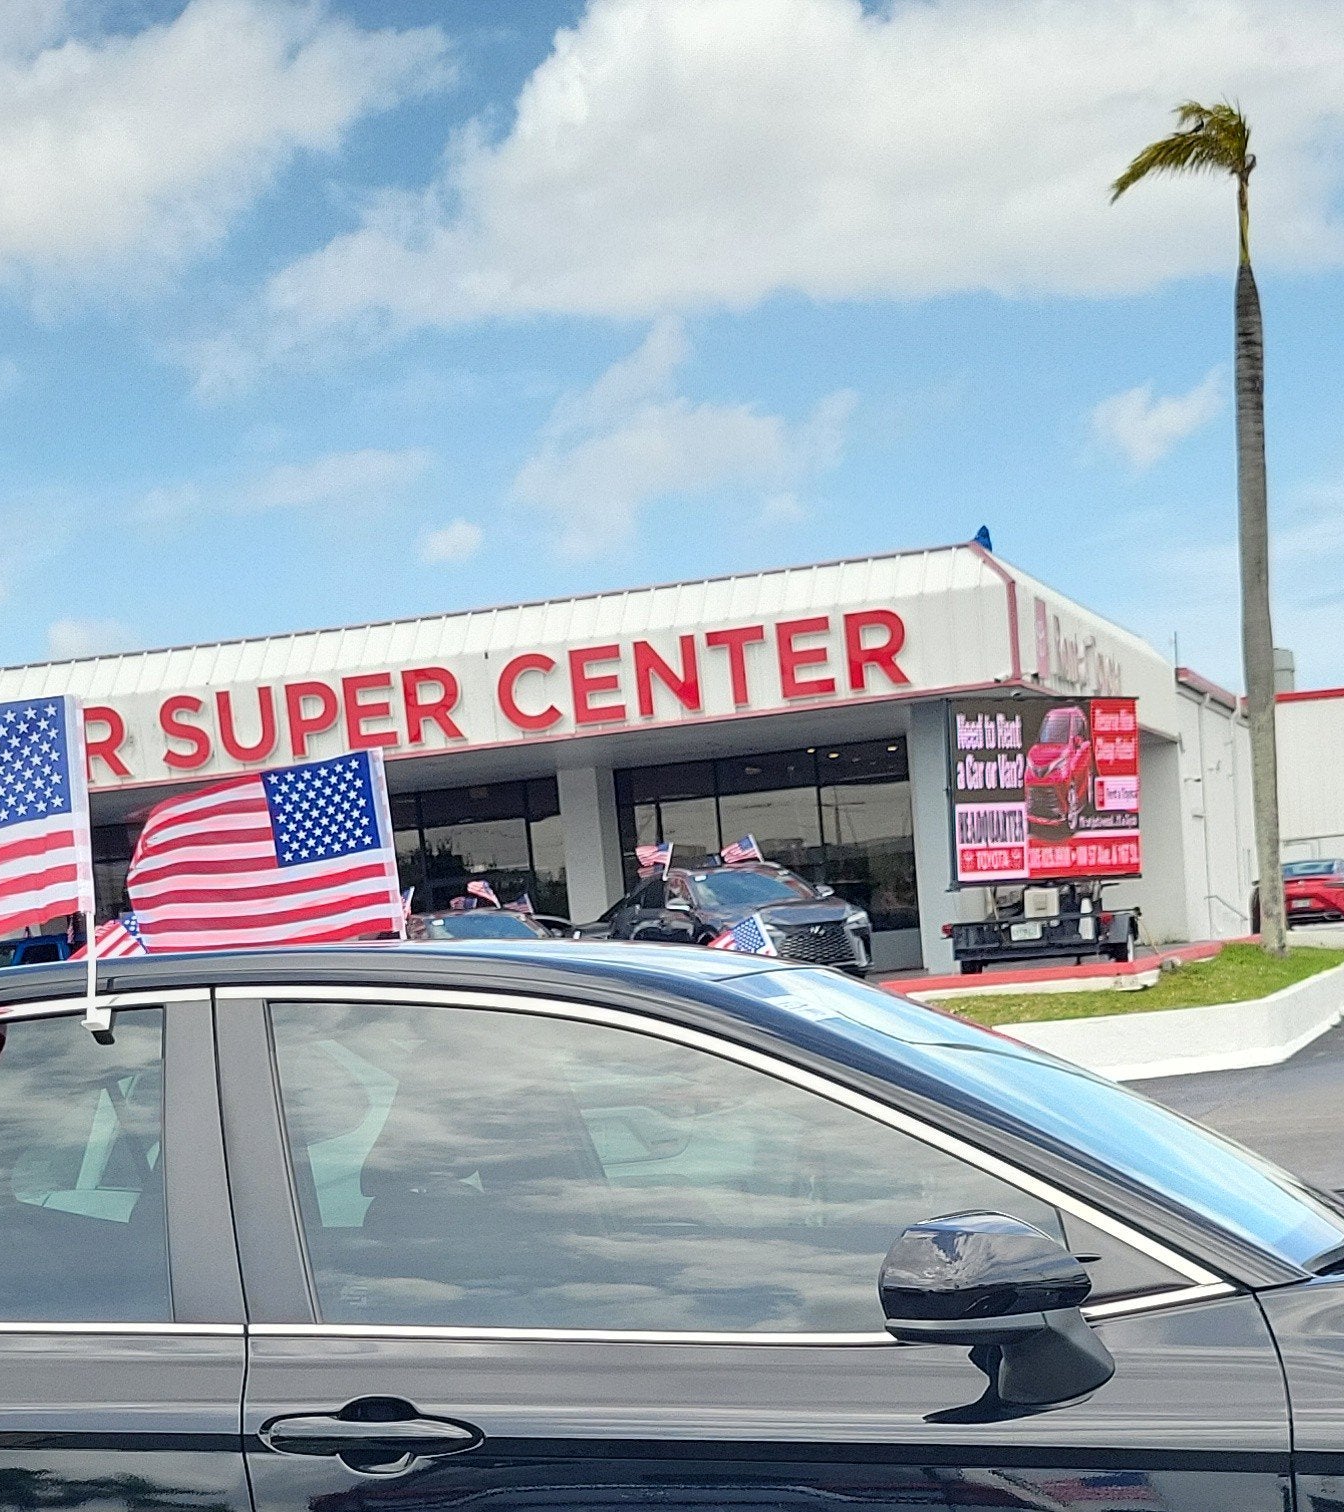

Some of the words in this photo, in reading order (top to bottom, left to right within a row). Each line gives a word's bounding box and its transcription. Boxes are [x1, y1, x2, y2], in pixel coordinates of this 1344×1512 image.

[158, 666, 467, 771] SUPER
[497, 608, 911, 733] CENTER
[956, 711, 984, 750] Need
[984, 713, 996, 750] to
[996, 711, 1023, 750] Rent
[956, 761, 965, 790] a
[965, 753, 984, 790] Car
